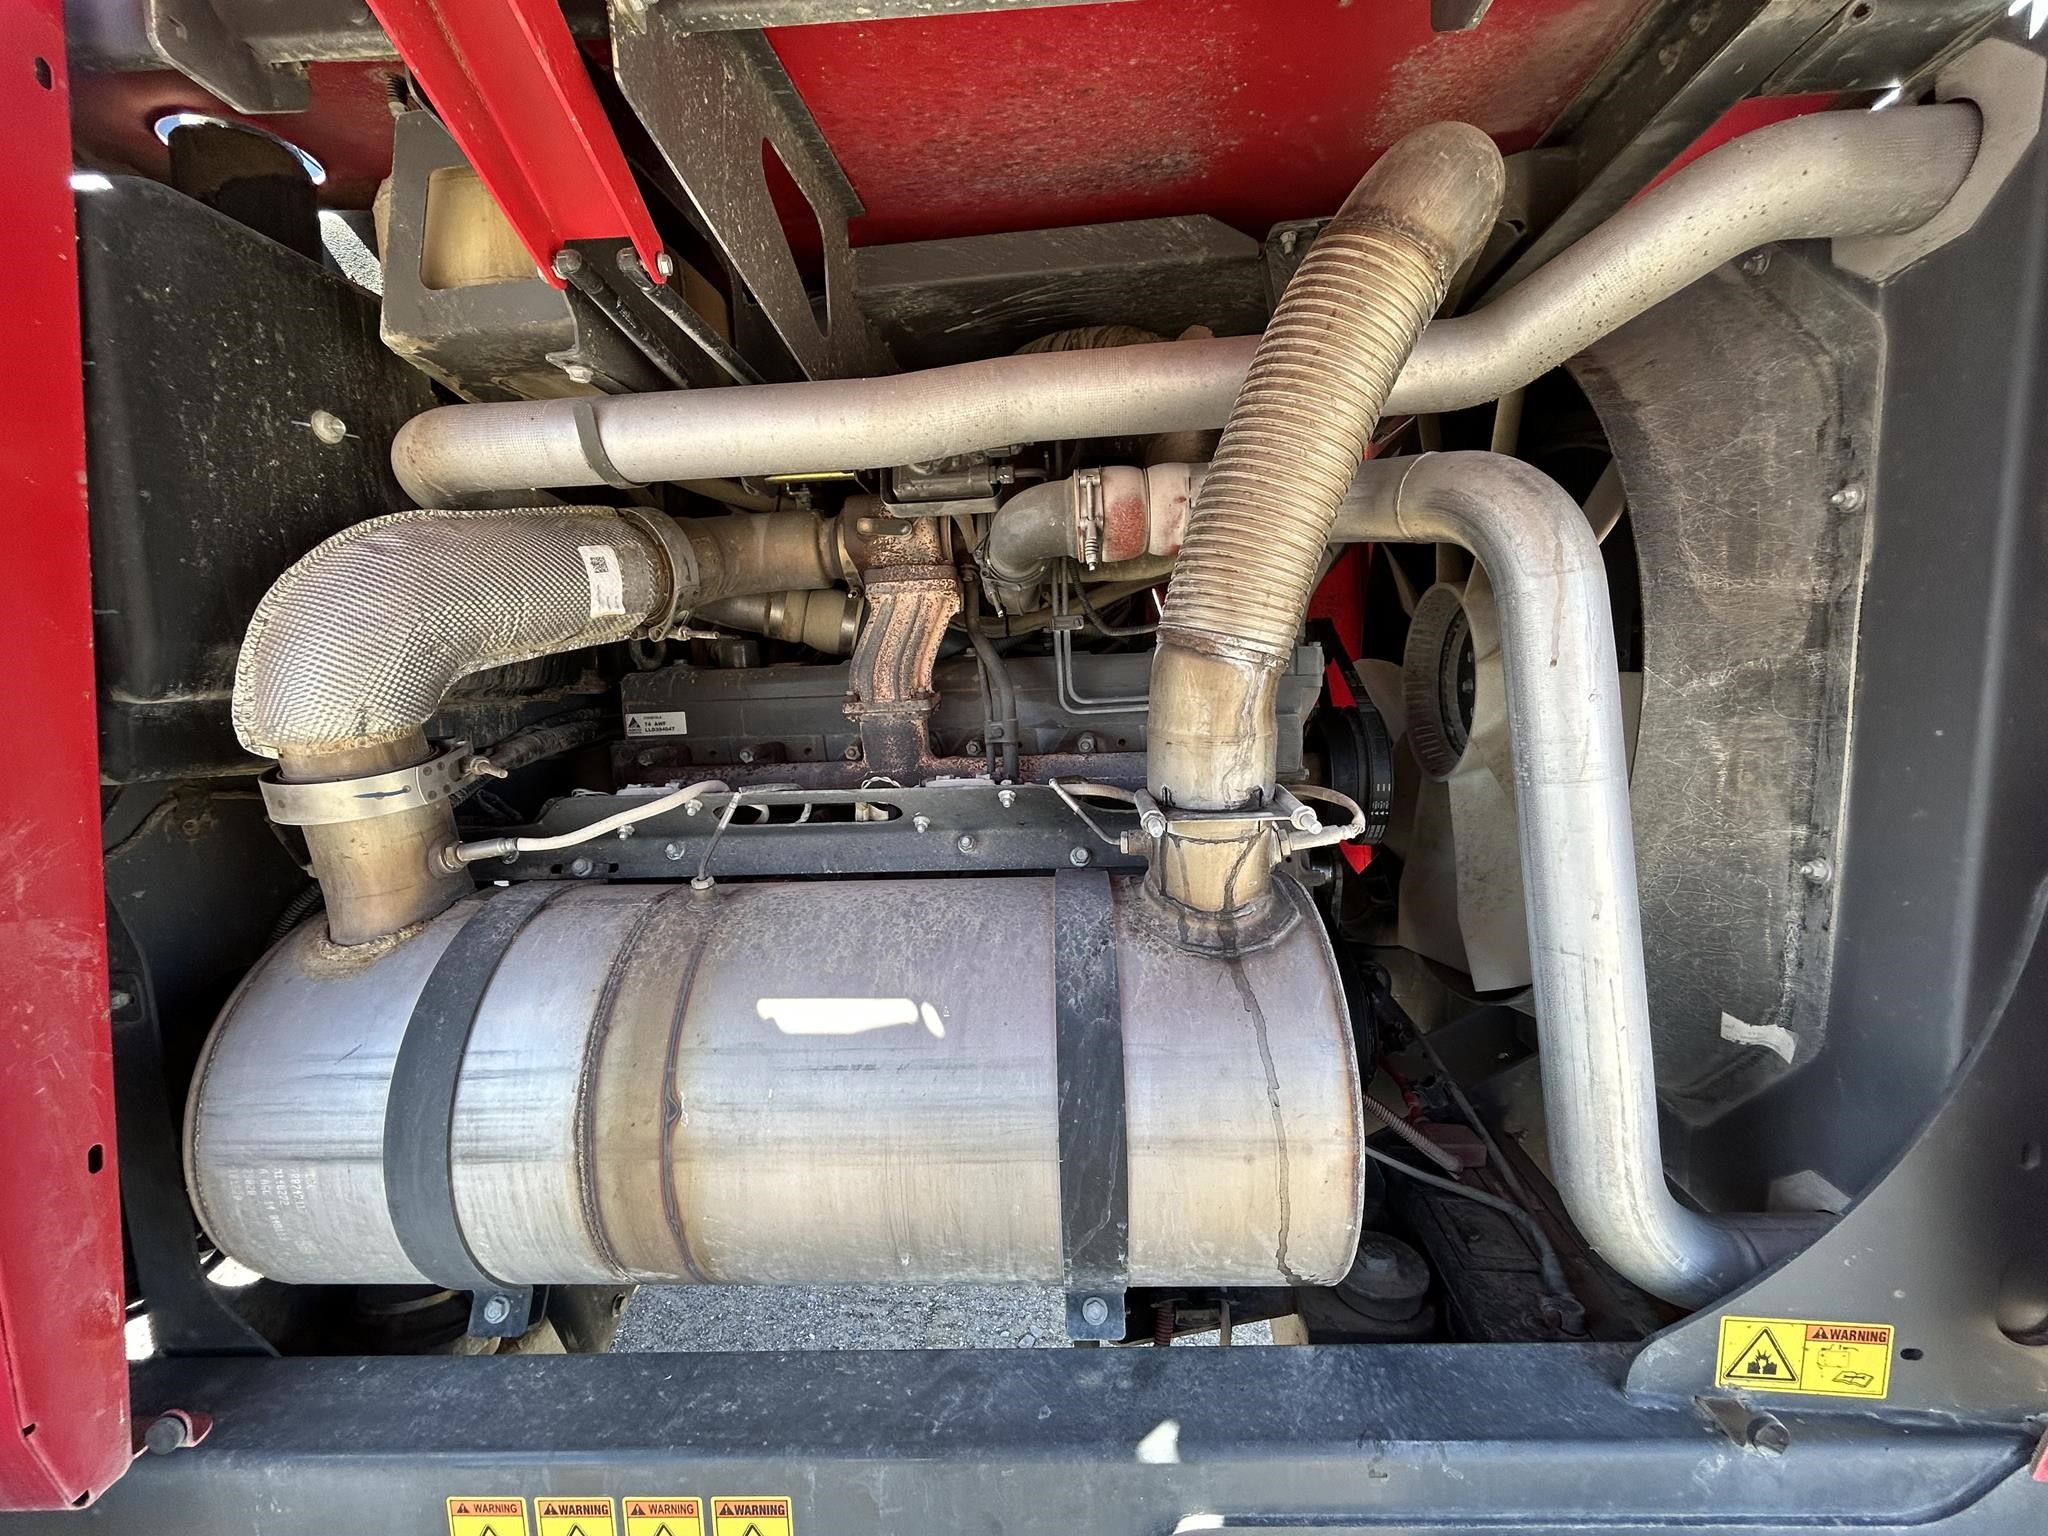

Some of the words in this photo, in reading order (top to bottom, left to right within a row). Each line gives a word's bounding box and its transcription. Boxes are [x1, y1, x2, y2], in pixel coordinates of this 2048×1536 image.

[1829, 1328, 1887, 1343] WARNING
[473, 1503, 518, 1515] WARNING
[558, 1503, 609, 1516] WARNING
[649, 1503, 694, 1515] WARNING
[735, 1503, 785, 1516] WARNING
